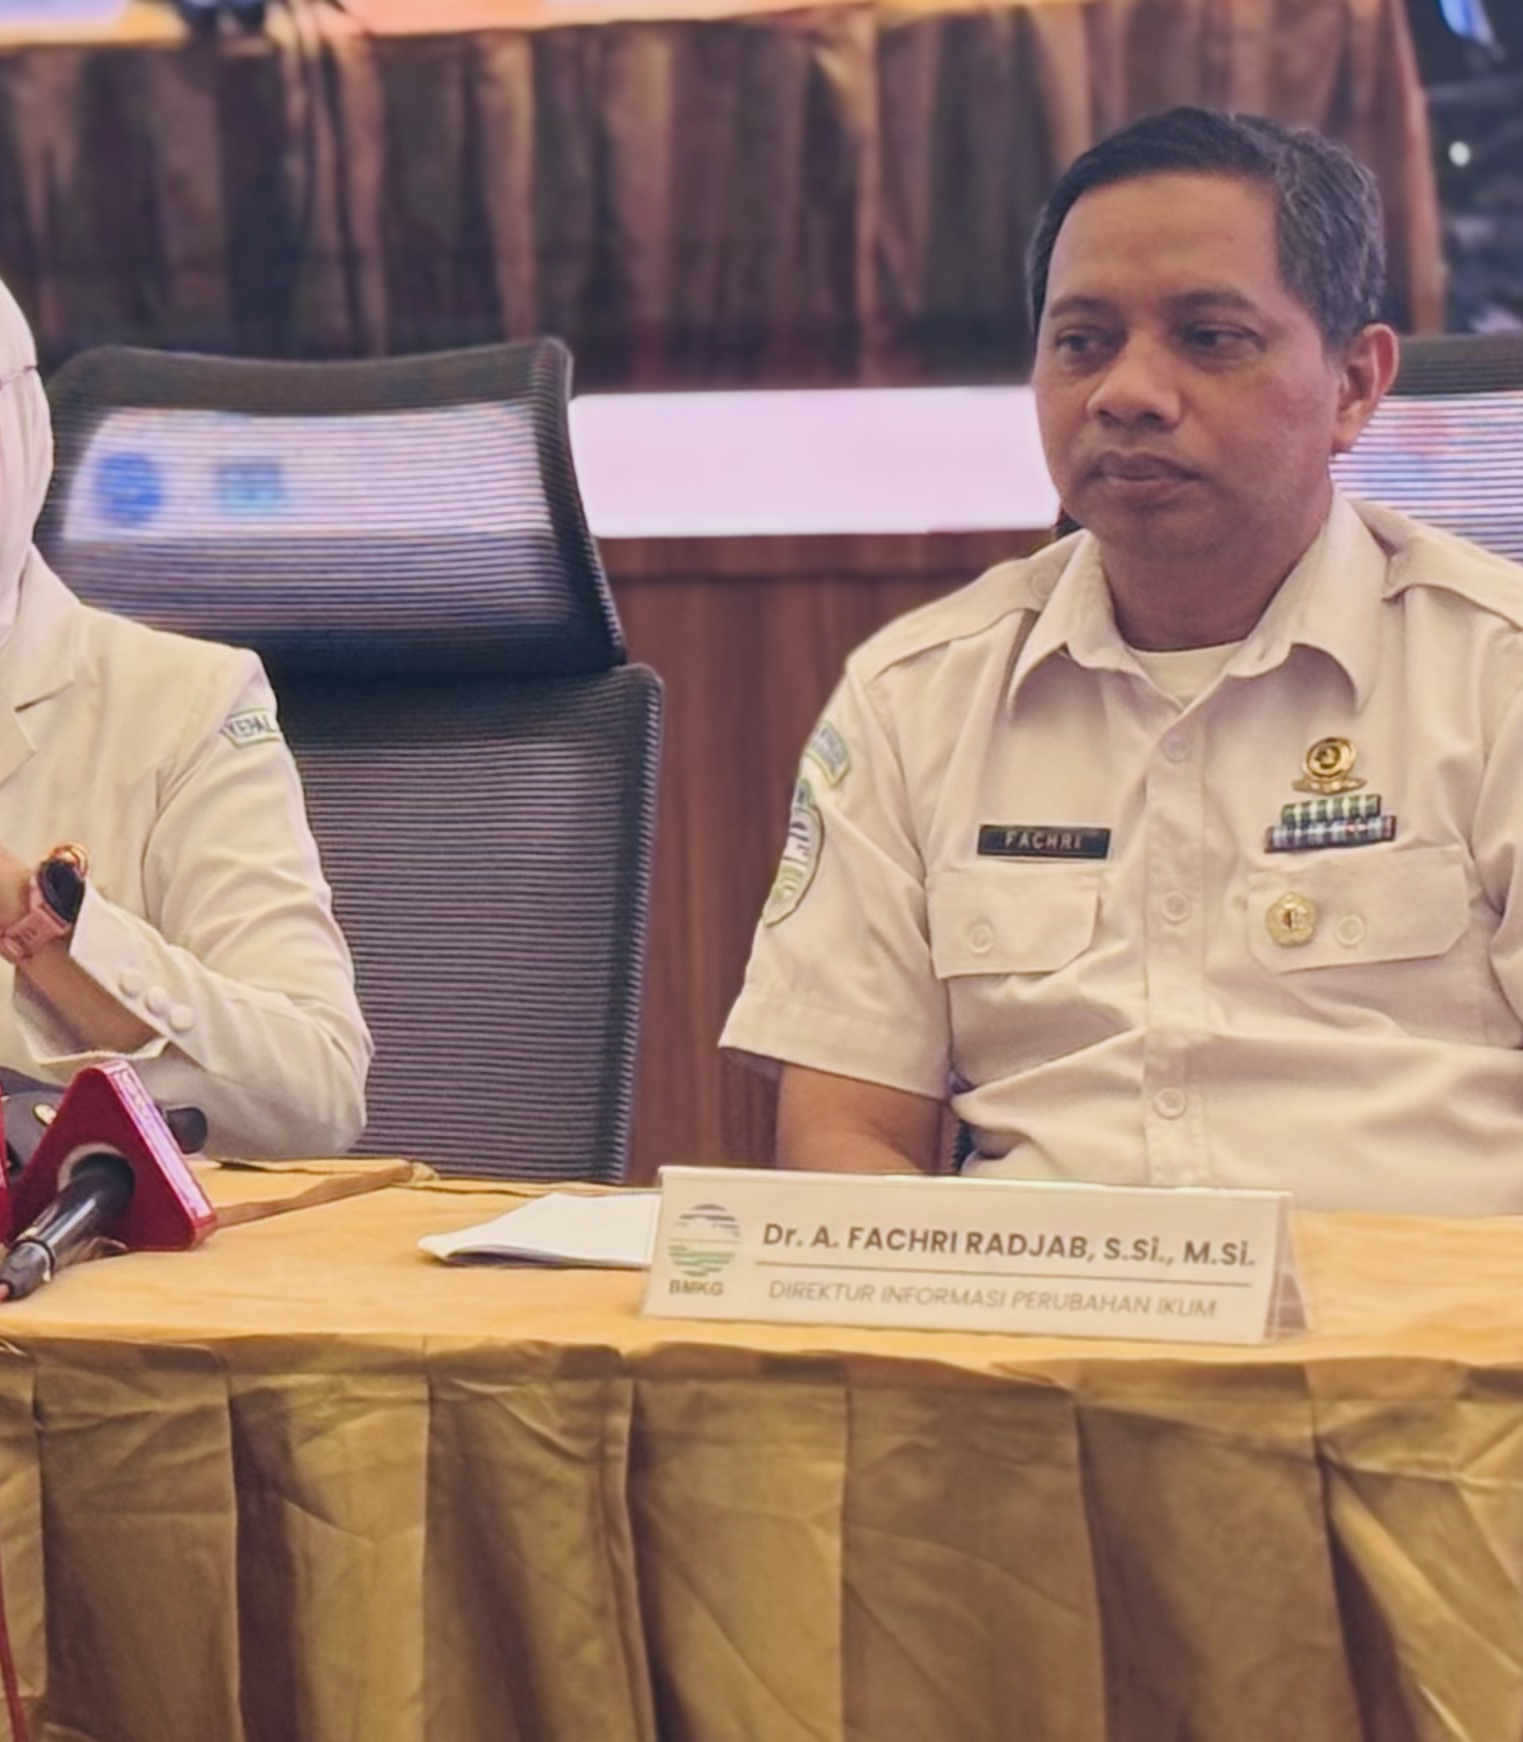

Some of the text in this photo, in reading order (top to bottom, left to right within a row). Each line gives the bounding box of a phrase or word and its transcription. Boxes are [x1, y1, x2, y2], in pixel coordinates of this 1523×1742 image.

[1004, 831, 1082, 850] FACHRI
[762, 1223, 1256, 1267] Dr. A. FACHRI RADJAB, S.Si., M.Si.
[668, 1279, 724, 1297] BMKG
[768, 1279, 875, 1301] DIREKTUR
[881, 1285, 1008, 1310] INFORMASI
[1011, 1290, 1151, 1315] PERUBAHAN
